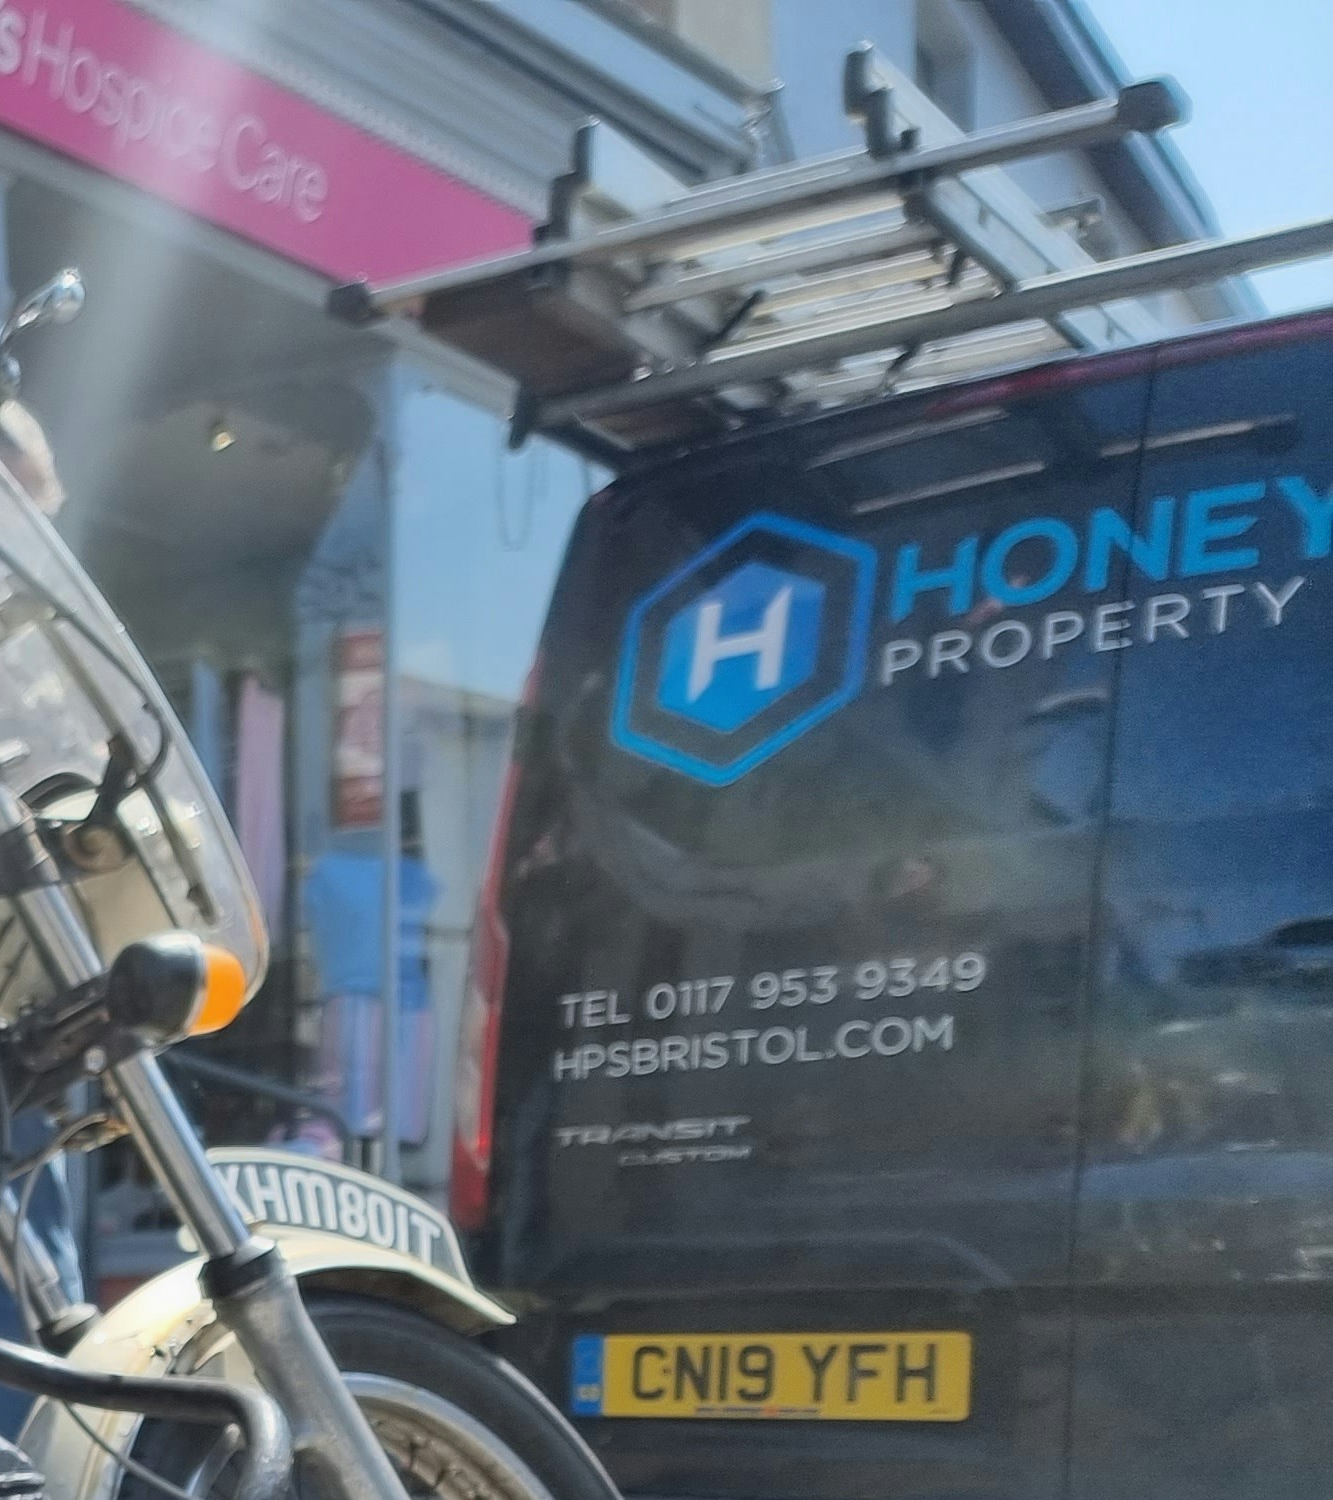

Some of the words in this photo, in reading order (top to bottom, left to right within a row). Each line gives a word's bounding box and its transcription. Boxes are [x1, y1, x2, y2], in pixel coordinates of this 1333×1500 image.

[21, 7, 220, 171] Hospice
[225, 114, 328, 222] Care
[890, 474, 1333, 624] HONEY
[687, 586, 793, 704] H
[879, 576, 1306, 687] PROPERTY
[559, 989, 632, 1029] TEL
[645, 975, 735, 1021] 0117
[749, 965, 840, 1010] 953
[854, 951, 988, 1001] 9349
[552, 1014, 956, 1082] HPSBRISTOL.COM
[552, 1114, 753, 1148] TRANSIT
[633, 1344, 775, 1402] CN19
[801, 1342, 938, 1402] YFH
